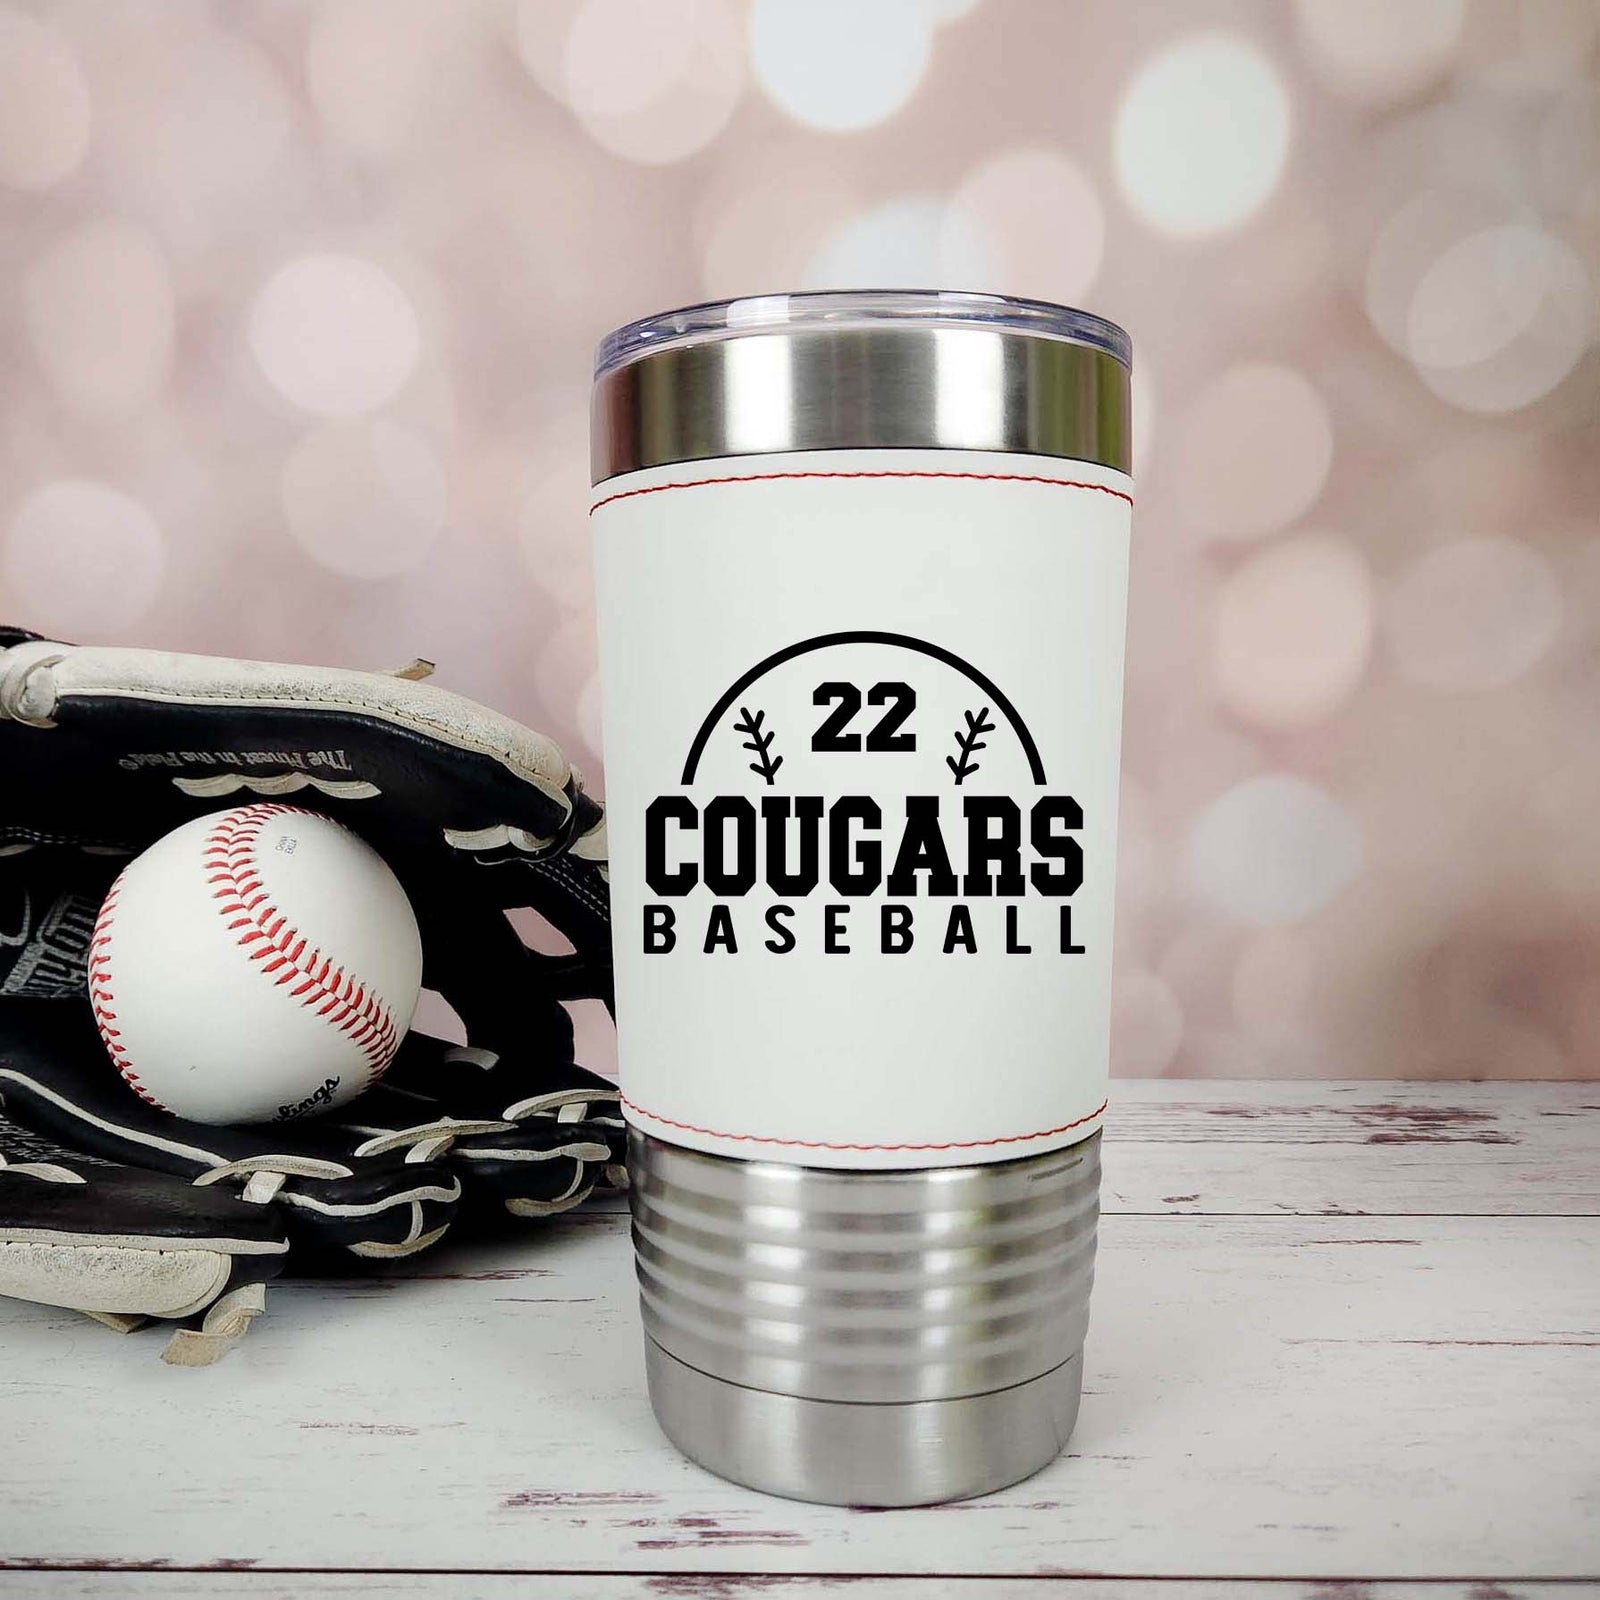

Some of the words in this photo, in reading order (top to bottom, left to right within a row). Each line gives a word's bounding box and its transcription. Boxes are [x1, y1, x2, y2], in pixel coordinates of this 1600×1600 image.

[811, 681, 917, 753] 22
[242, 751, 309, 769] Finest
[308, 749, 353, 771] The
[645, 795, 1084, 897] COUGARS
[643, 904, 1086, 955] BASEBALL
